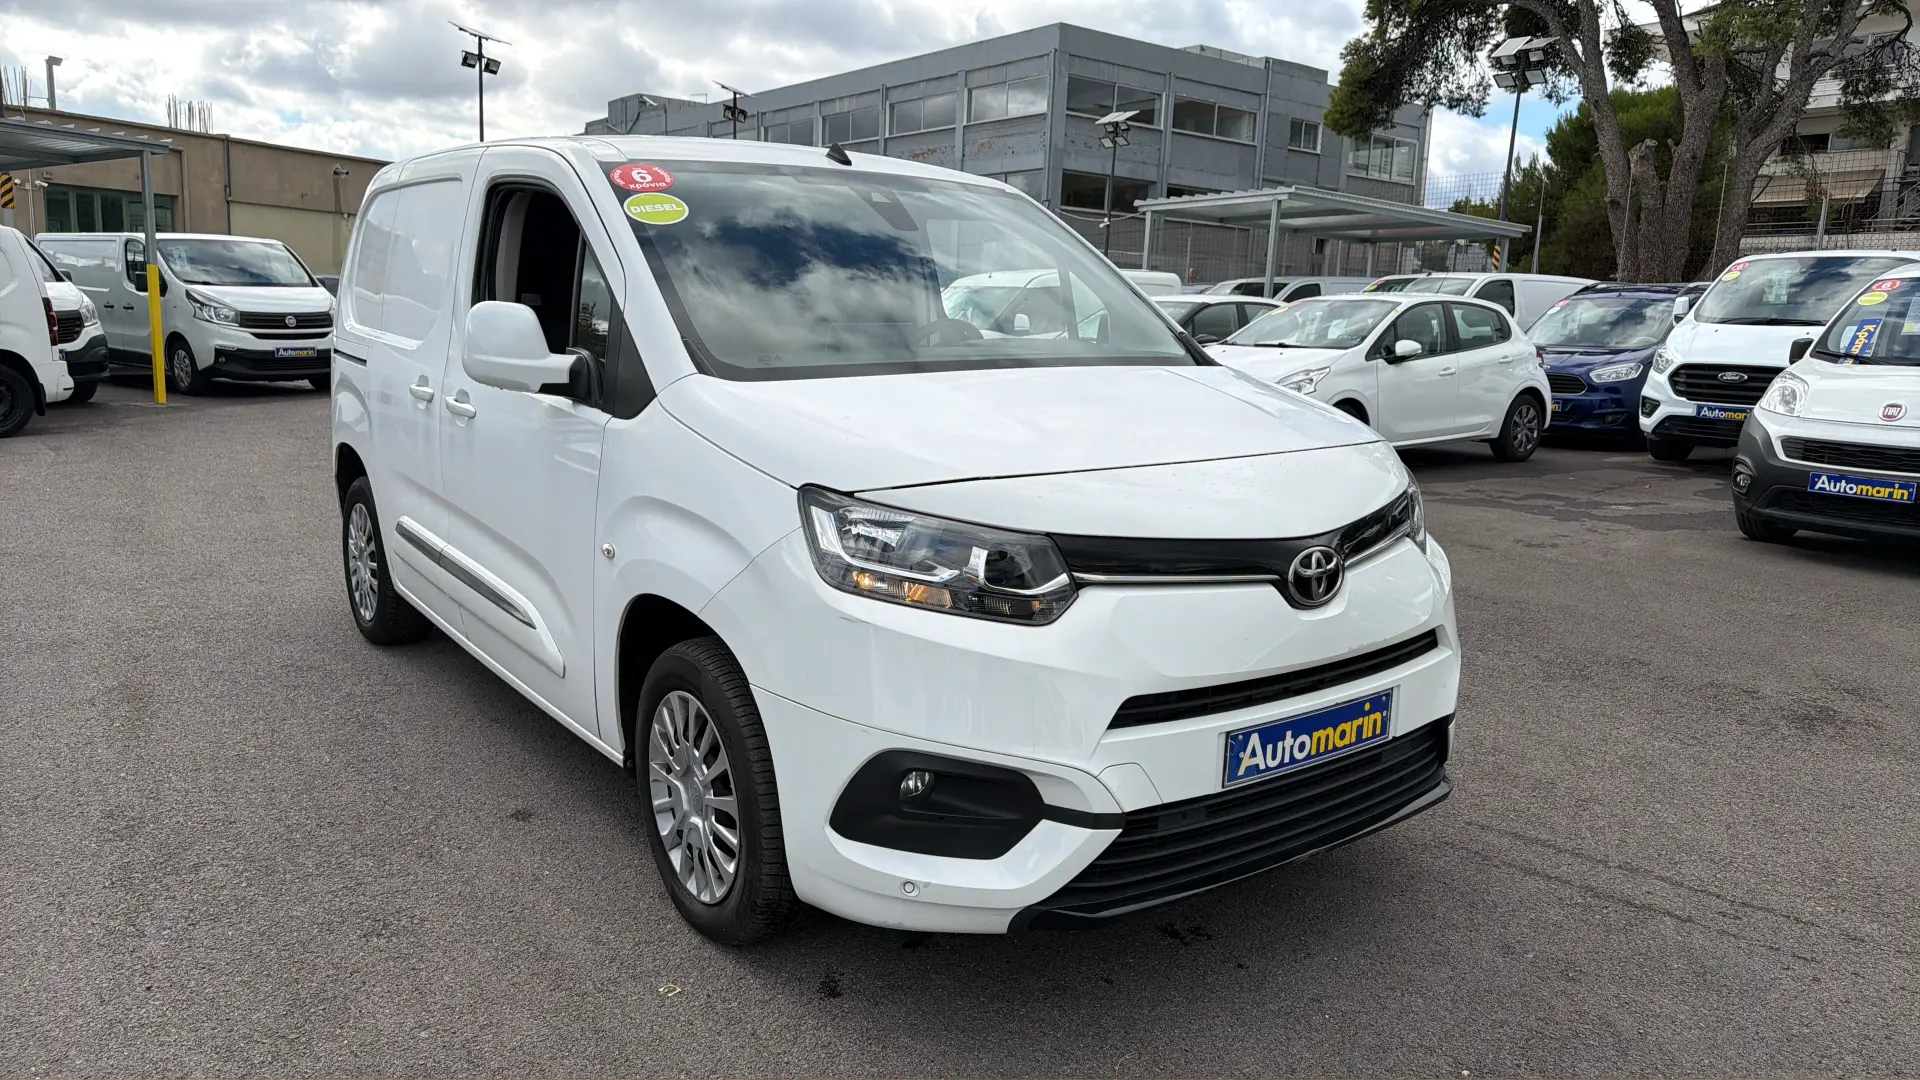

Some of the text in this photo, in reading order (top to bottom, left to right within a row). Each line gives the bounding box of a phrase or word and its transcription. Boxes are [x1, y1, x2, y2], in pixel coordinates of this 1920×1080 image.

[631, 169, 653, 183] 6
[629, 181, 667, 189] χρόνια
[630, 203, 682, 213] DIESEL
[1843, 324, 1877, 364] Κράτηη
[278, 348, 314, 356] Automarin
[1723, 372, 1740, 380] Ford
[1883, 407, 1901, 416] FIAT
[1814, 475, 1908, 500] Automarin
[1237, 702, 1382, 776] Automarin
